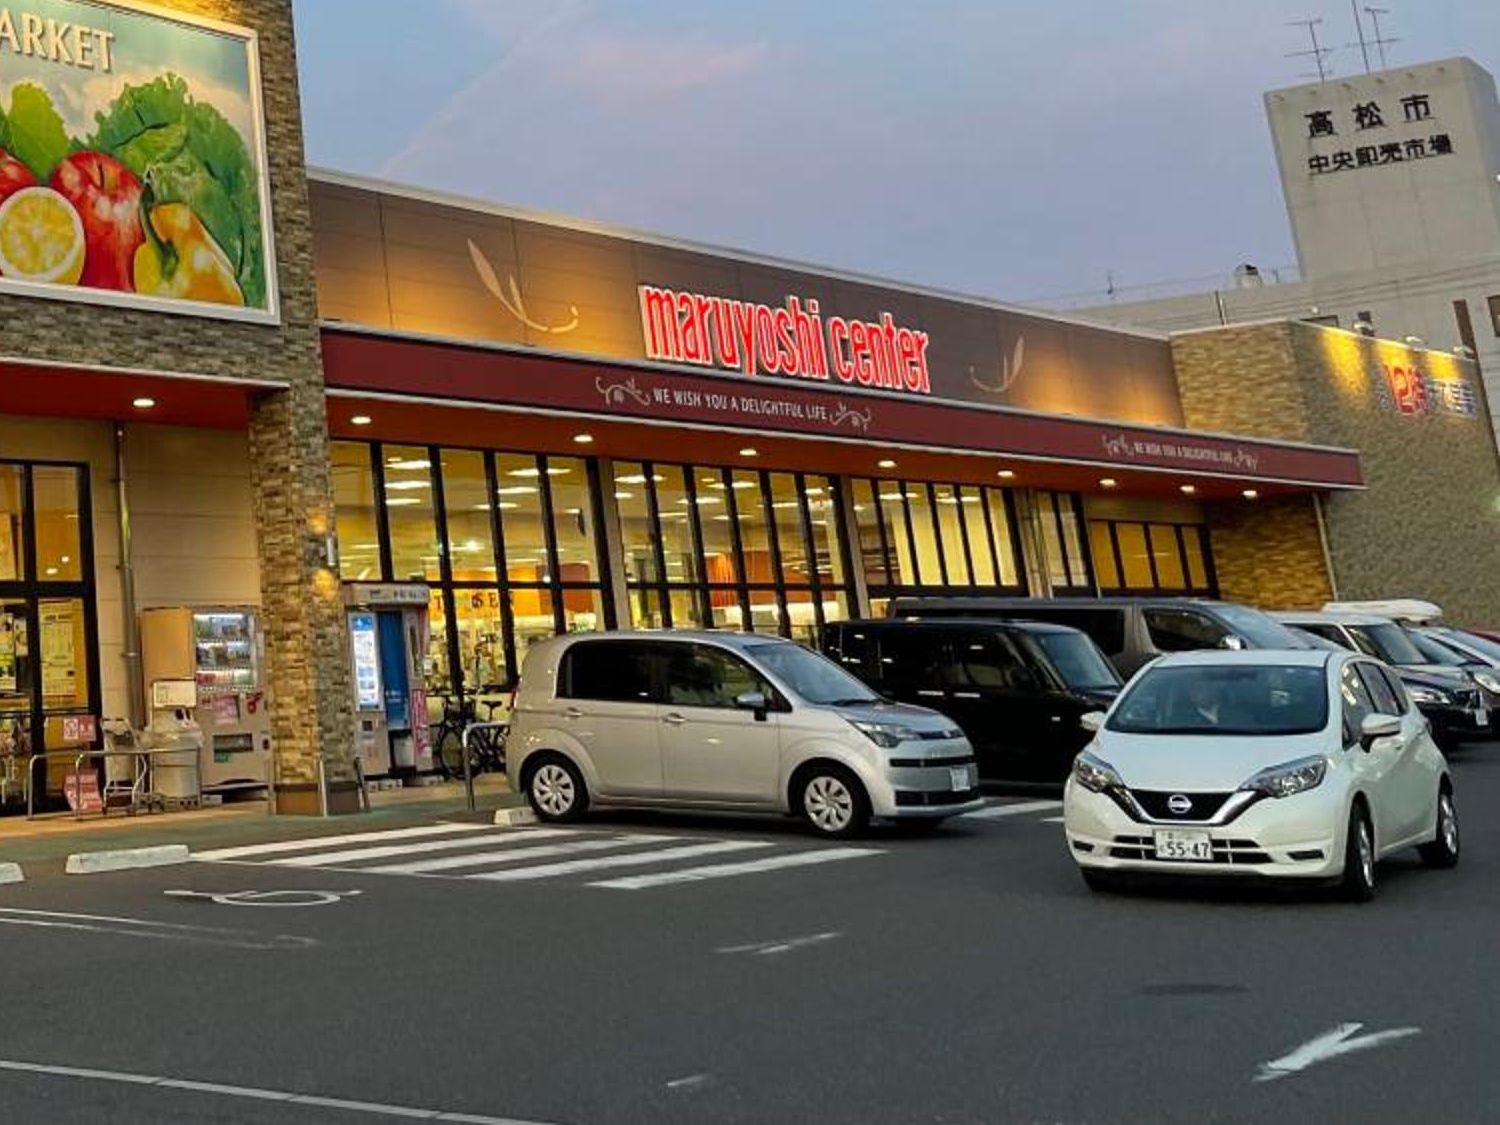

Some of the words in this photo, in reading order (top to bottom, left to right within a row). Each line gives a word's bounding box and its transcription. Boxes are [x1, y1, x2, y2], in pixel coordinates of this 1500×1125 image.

[1304, 93, 1435, 138] 高松市
[638, 285, 828, 379] maruyoshi
[830, 312, 931, 394] center
[653, 387, 671, 405] WE
[673, 389, 701, 408] WISH
[705, 393, 728, 410] YOU
[731, 397, 738, 412] A
[741, 398, 804, 419] DELIGHTFUL
[806, 405, 827, 421] LIFE
